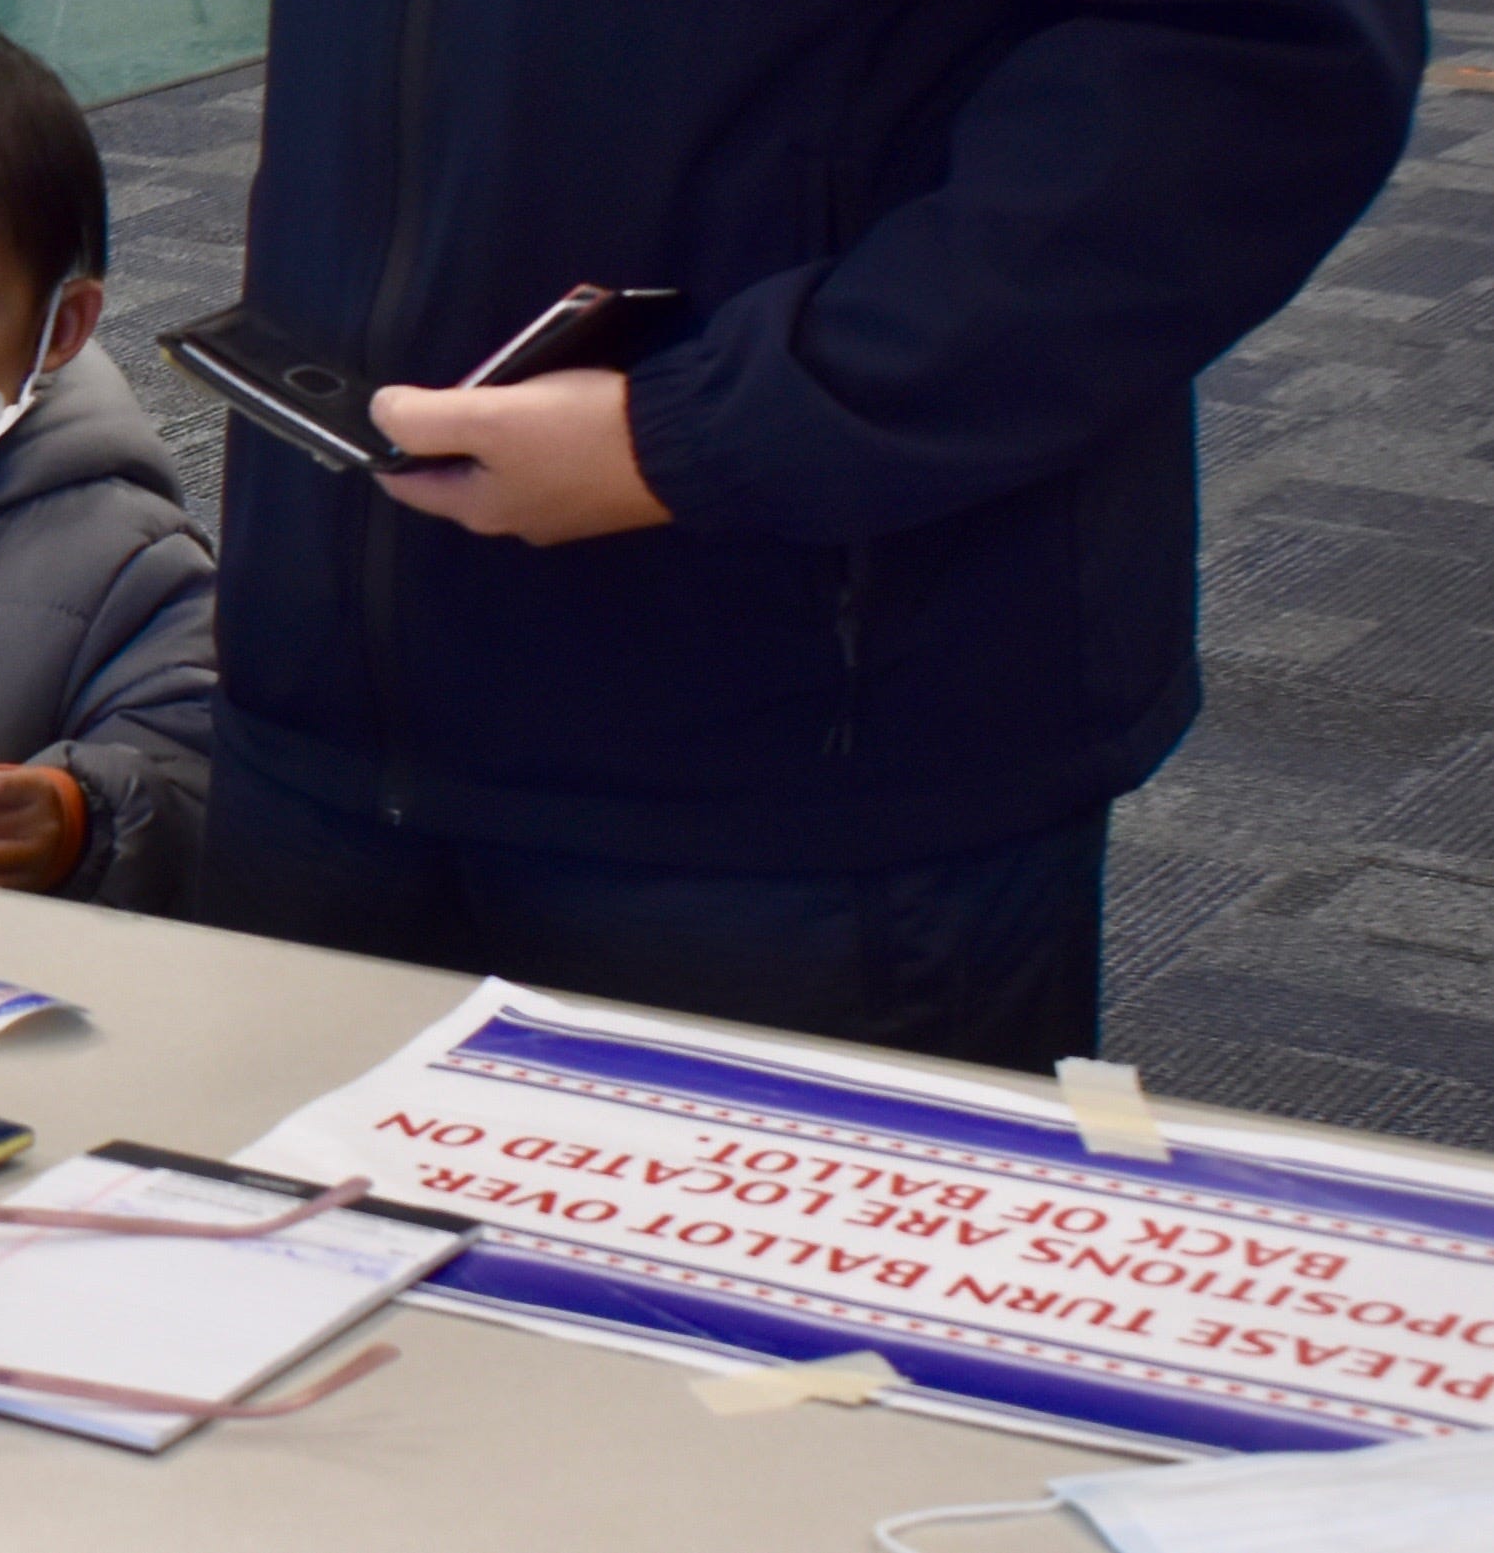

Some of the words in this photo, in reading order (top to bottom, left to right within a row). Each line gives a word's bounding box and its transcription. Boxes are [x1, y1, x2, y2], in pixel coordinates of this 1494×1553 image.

[374, 1111, 487, 1148] ON
[414, 1162, 621, 1225] OVER.
[499, 1136, 836, 1218] LOCATED
[695, 1134, 989, 1213] BALLOT.
[851, 1203, 1006, 1249] ARE
[1003, 1199, 1110, 1235] OF
[634, 1213, 931, 1290] BALLOT
[1132, 1217, 1349, 1283] BACK
[945, 1274, 1159, 1336] TURN
[1184, 1322, 1494, 1403] PLEASE
